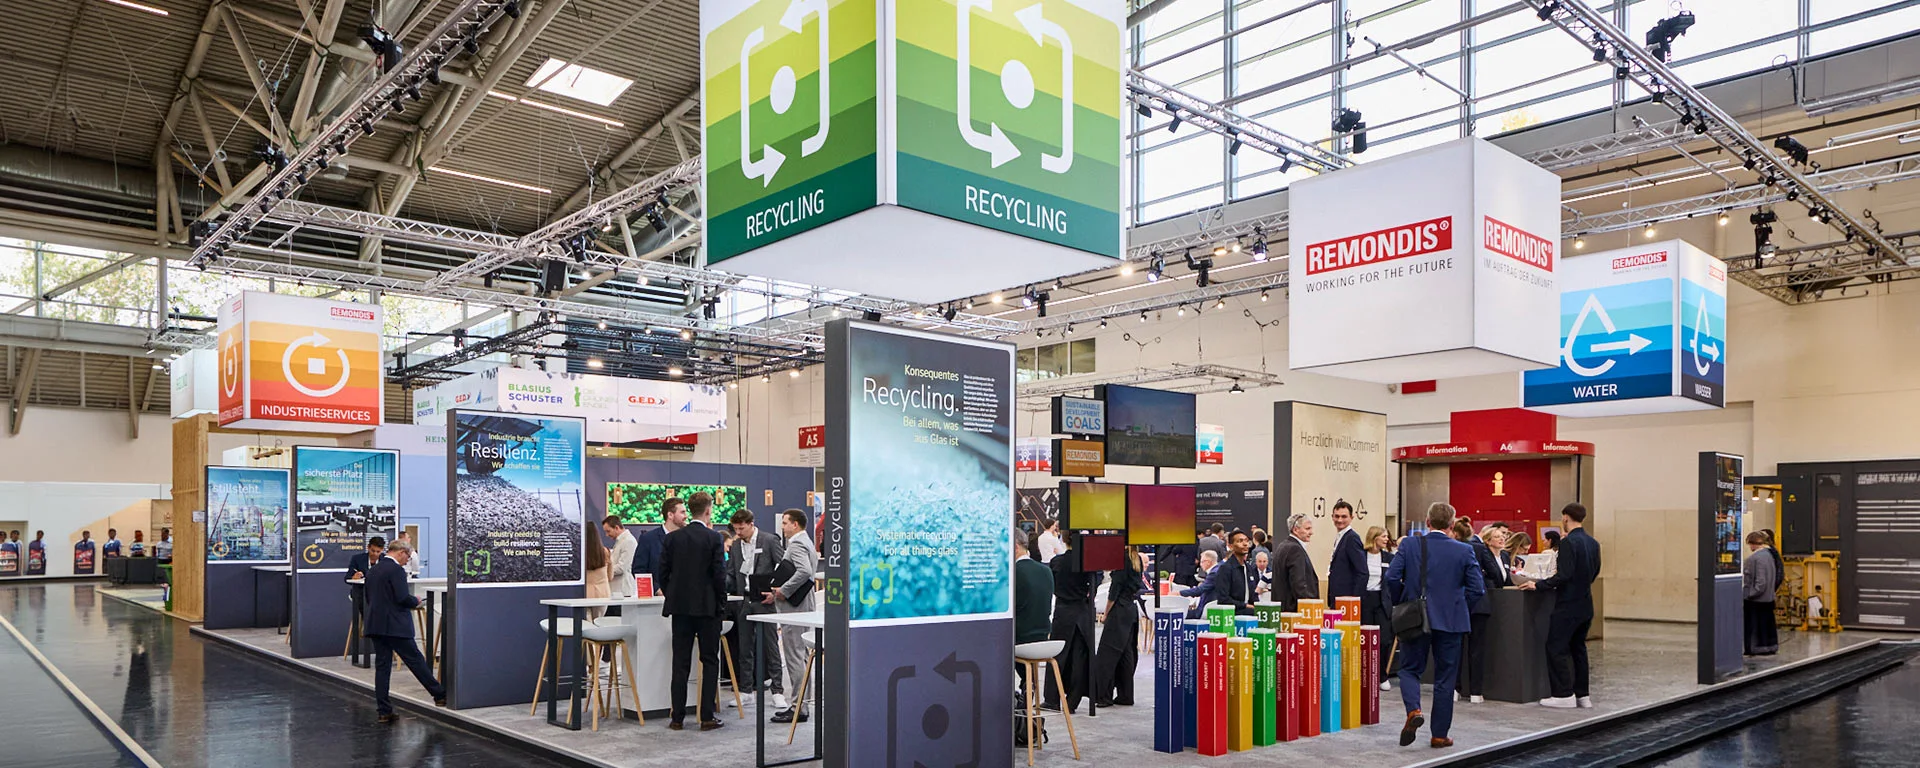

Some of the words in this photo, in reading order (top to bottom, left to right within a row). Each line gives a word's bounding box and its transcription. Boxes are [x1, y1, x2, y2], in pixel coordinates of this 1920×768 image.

[745, 188, 825, 240] RECYCLING
[965, 184, 1068, 235] RECYCLING
[1306, 275, 1355, 293] WORKING
[1359, 271, 1380, 284] FOR
[1384, 266, 1404, 279] THE
[1409, 258, 1453, 275] FUTURE
[904, 364, 960, 382] Konsequentes
[508, 383, 552, 394] BLASIUS
[1572, 383, 1618, 399] WATER
[508, 393, 563, 404] SCHUSTER
[863, 377, 960, 417] Recycling.
[1065, 400, 1100, 410] SUSTAINABLE
[260, 404, 371, 421] INDUSTRIESERVICES
[1065, 408, 1100, 417] DEVELOPMENT
[903, 416, 916, 427] Bei
[917, 417, 942, 431] allem,
[943, 421, 960, 431] was
[1065, 415, 1101, 430] GOALS
[488, 432, 516, 442] Industrie
[806, 433, 818, 447] A5
[913, 435, 929, 444] aus
[930, 434, 948, 445] Glas
[949, 435, 960, 447] ist
[1300, 431, 1333, 448] Herzlich
[1335, 435, 1380, 453] willkommen
[471, 441, 541, 461] Resilienz.
[1426, 445, 1468, 454] Information
[1500, 443, 1513, 451] A6
[1543, 443, 1579, 452] Information
[491, 461, 504, 469] Wir
[504, 462, 530, 470] schaffen
[1323, 455, 1359, 473] Welcome
[304, 468, 341, 478] sicherste
[342, 469, 363, 479] Platz
[828, 476, 844, 568] Recycling
[487, 530, 514, 539] Industry
[876, 528, 920, 541] Systematic
[493, 539, 510, 547] build
[503, 548, 515, 556] We
[526, 548, 541, 557] help
[884, 544, 898, 556] For
[900, 544, 910, 556] all
[912, 545, 937, 558] things
[937, 545, 959, 558] glass
[1256, 611, 1268, 622] 13
[1271, 611, 1280, 622] 13
[1301, 608, 1311, 619] 11
[1314, 608, 1322, 619] 11
[1353, 605, 1359, 616] 9
[1157, 618, 1169, 631] 17
[1172, 618, 1182, 631] 17
[1209, 615, 1221, 627] 15
[1224, 615, 1233, 627] 15
[1184, 630, 1195, 642] 16
[1298, 634, 1305, 646] 5
[1312, 634, 1318, 646] 5
[1353, 630, 1358, 641] 7
[1372, 634, 1378, 645] 8
[1202, 643, 1210, 656] 1
[1218, 643, 1224, 656] 1
[1253, 639, 1259, 651] 3
[1267, 639, 1273, 651] 3
[1276, 643, 1282, 655] 4
[1290, 643, 1295, 655] 4
[1320, 639, 1327, 650] 6
[1333, 638, 1339, 650] 6
[1228, 647, 1235, 660] 2
[1244, 647, 1249, 660] 2
